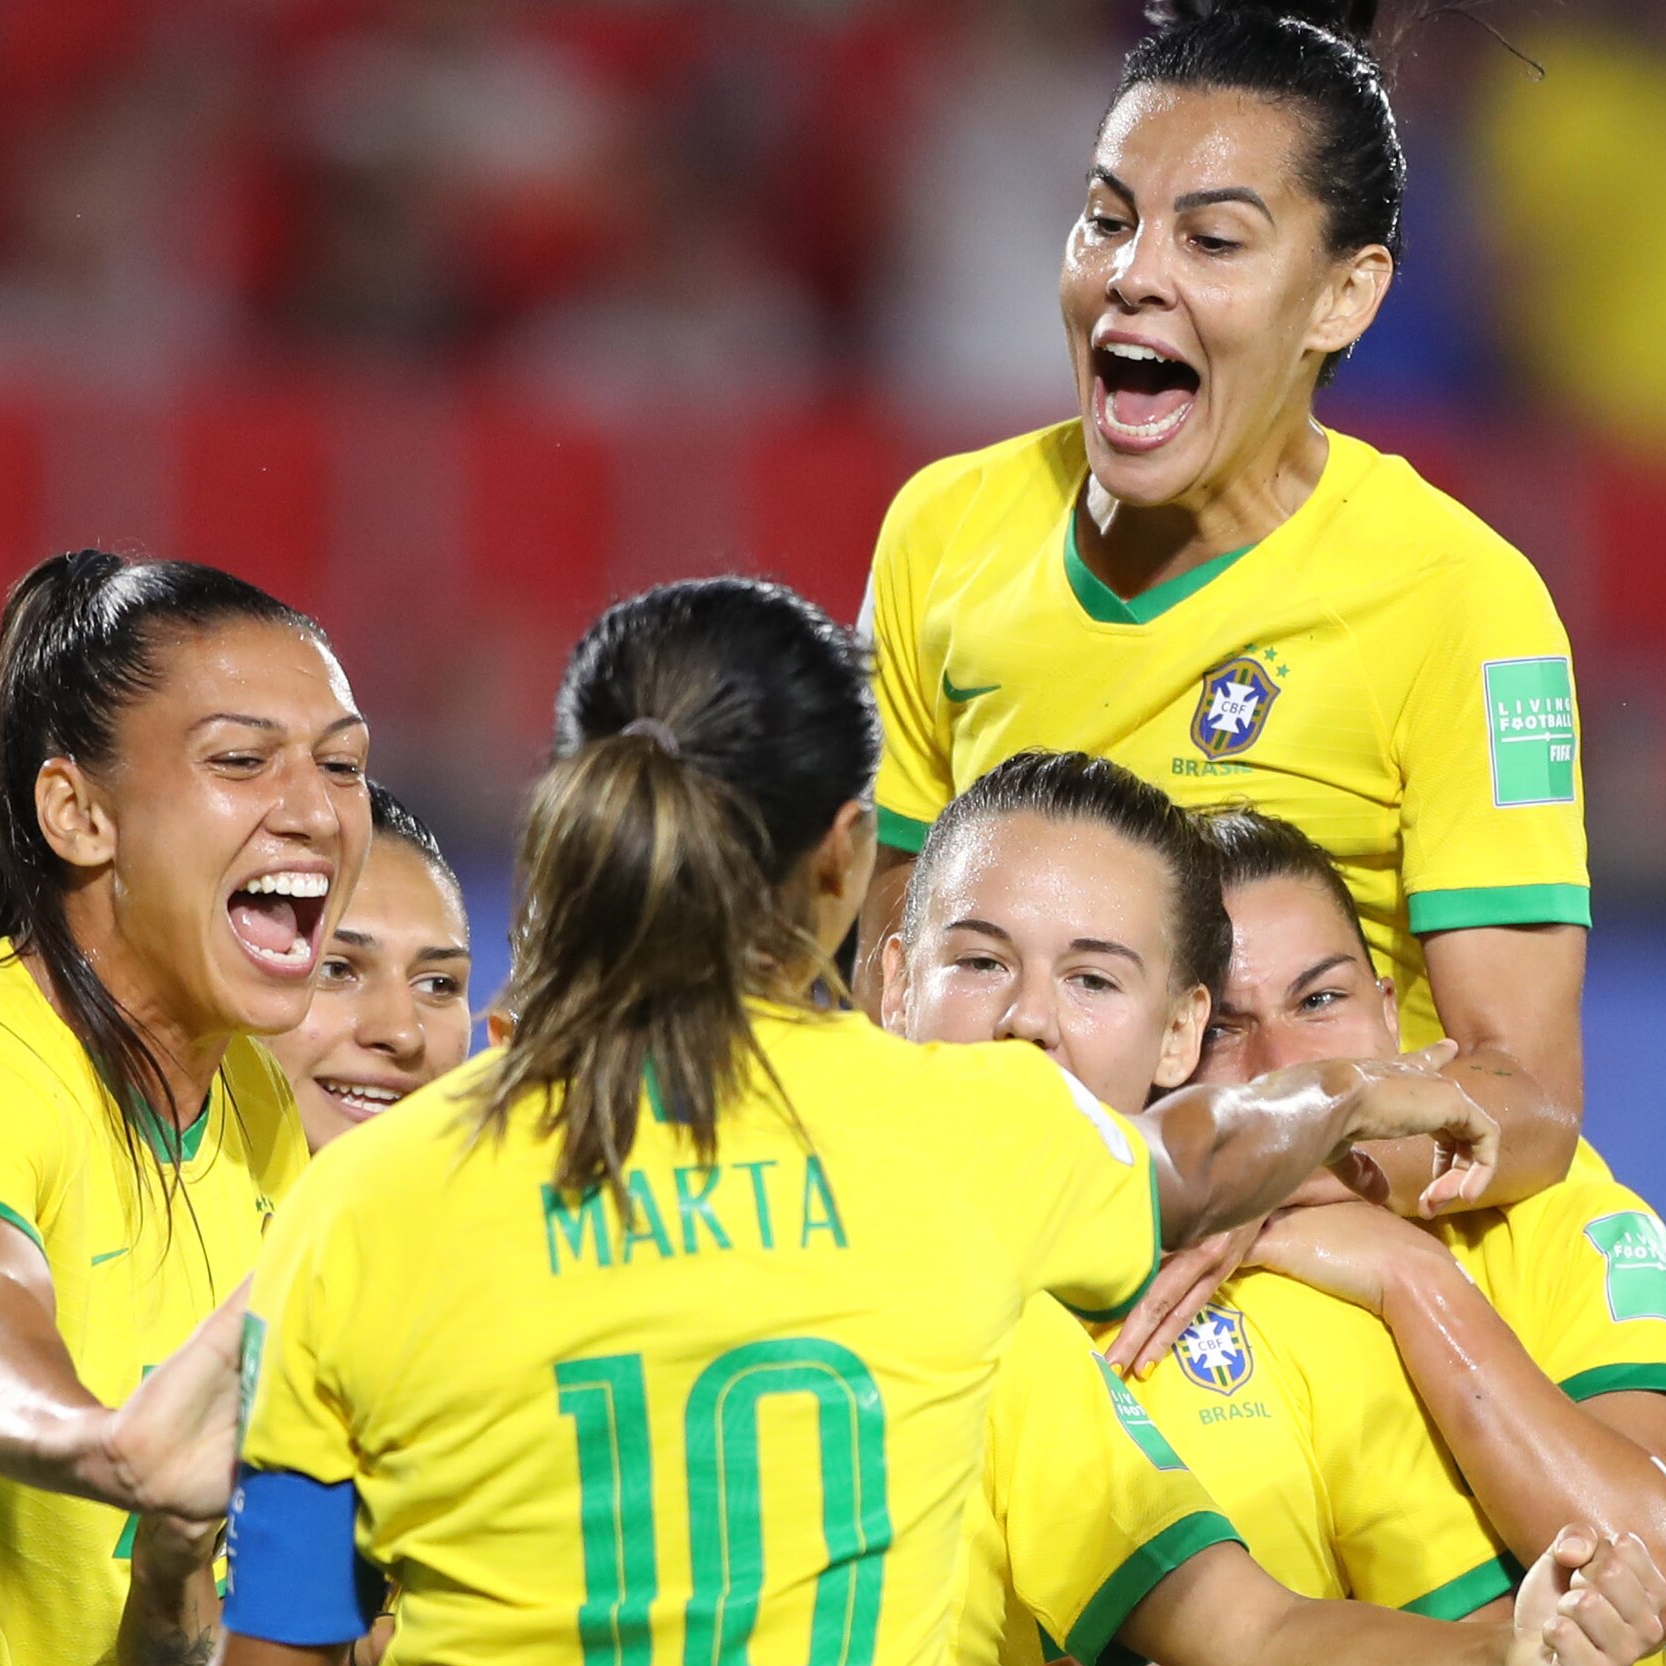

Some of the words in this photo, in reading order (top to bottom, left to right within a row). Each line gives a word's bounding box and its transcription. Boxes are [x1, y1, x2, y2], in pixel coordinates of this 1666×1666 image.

[1221, 701, 1247, 715] CBF
[1498, 698, 1571, 716] LIVING
[1499, 713, 1572, 731] FOOTBALL
[1549, 744, 1571, 762] FIFA
[539, 1155, 848, 1275] MARTA
[1198, 1338, 1225, 1351] CBF
[1198, 1401, 1272, 1425] BRASIL
